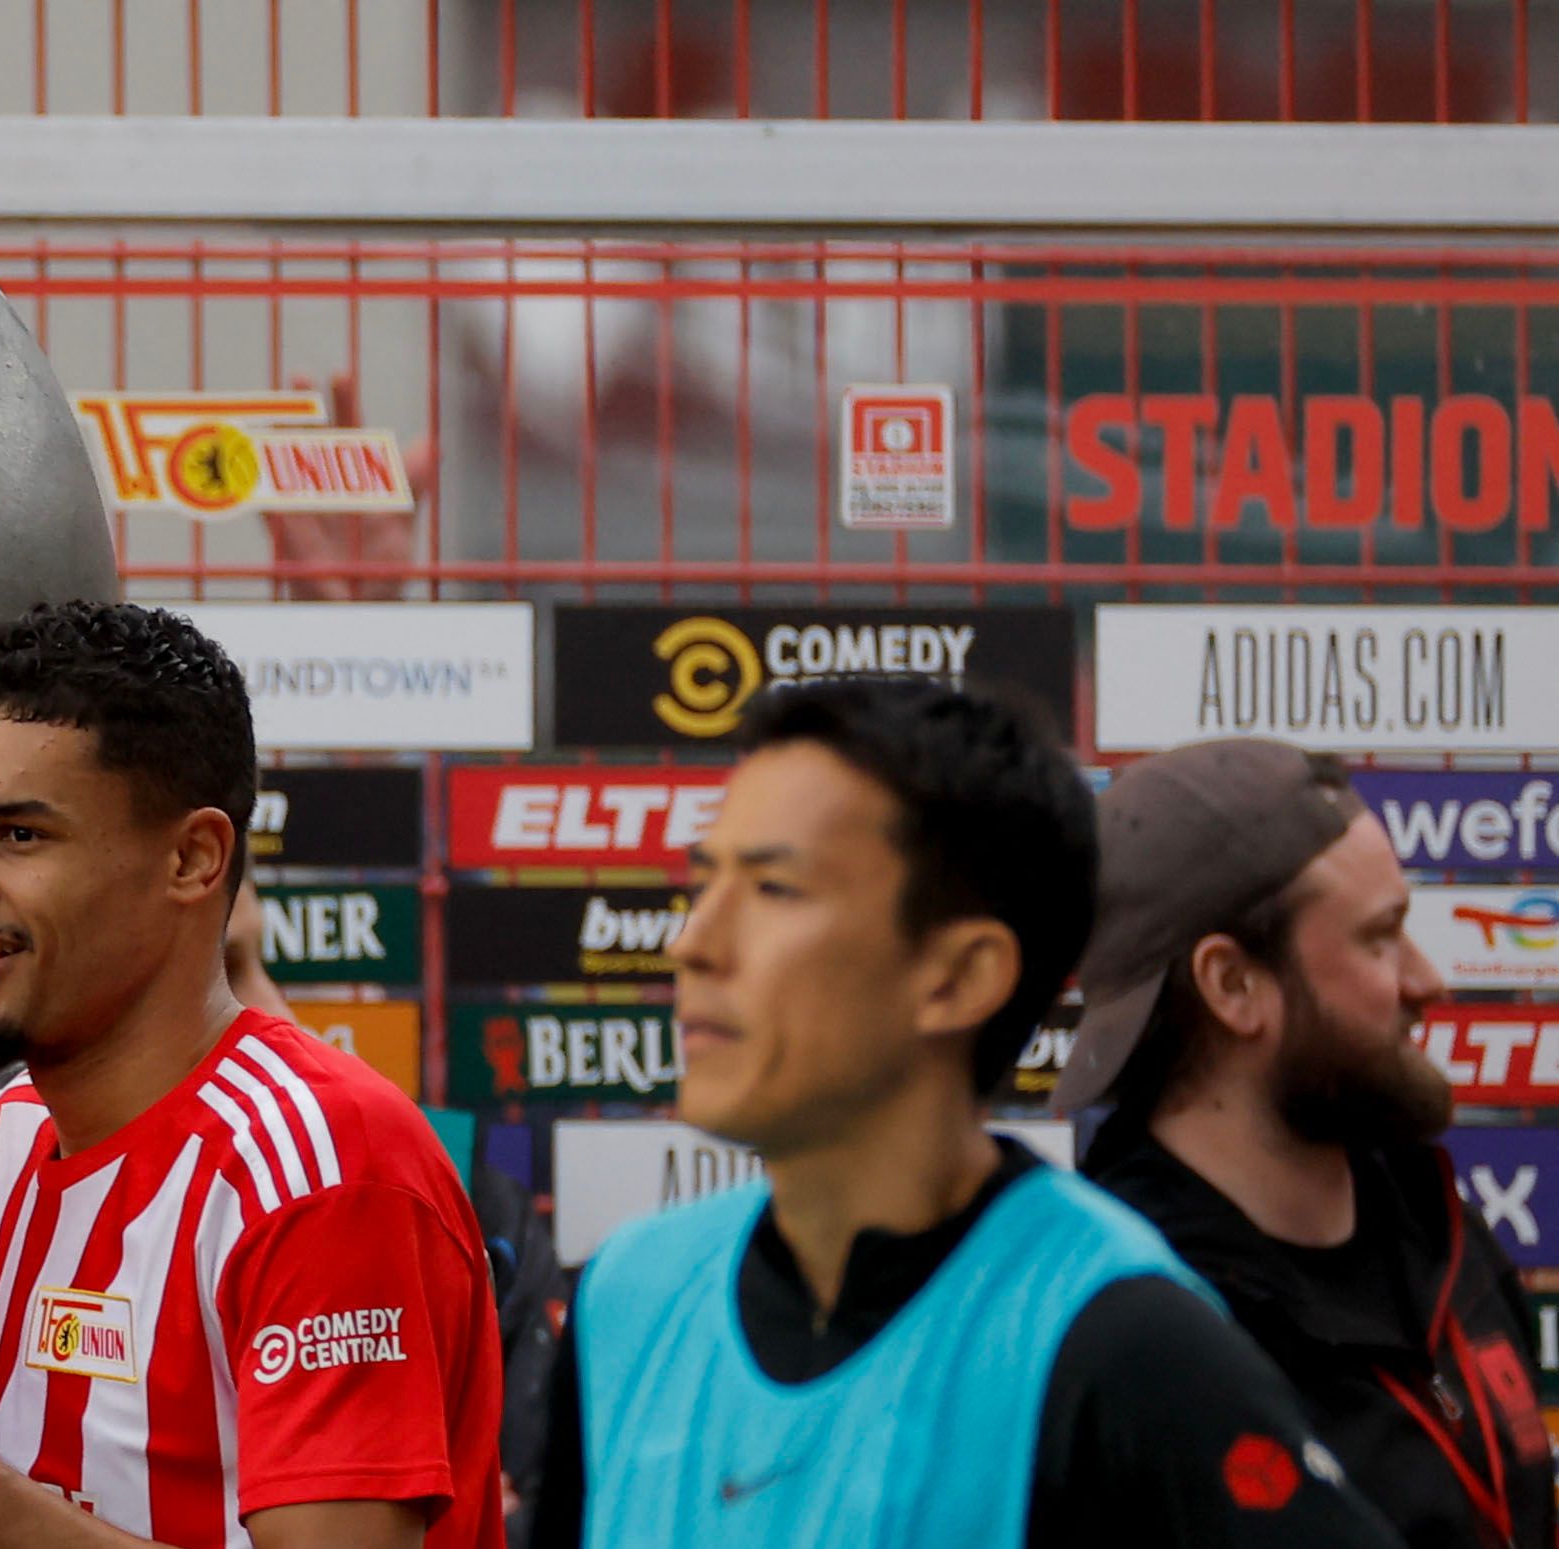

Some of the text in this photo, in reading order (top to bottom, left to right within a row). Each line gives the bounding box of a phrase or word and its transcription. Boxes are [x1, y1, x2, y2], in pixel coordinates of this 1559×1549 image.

[265, 440, 395, 493] UNION
[765, 624, 975, 676] COMEDY
[1197, 627, 1506, 731] ADIDAS.COM
[1382, 780, 1559, 861] wef
[82, 1325, 125, 1361] UNION
[297, 1307, 403, 1343] COMEDY
[299, 1335, 407, 1371] CENTRAL
